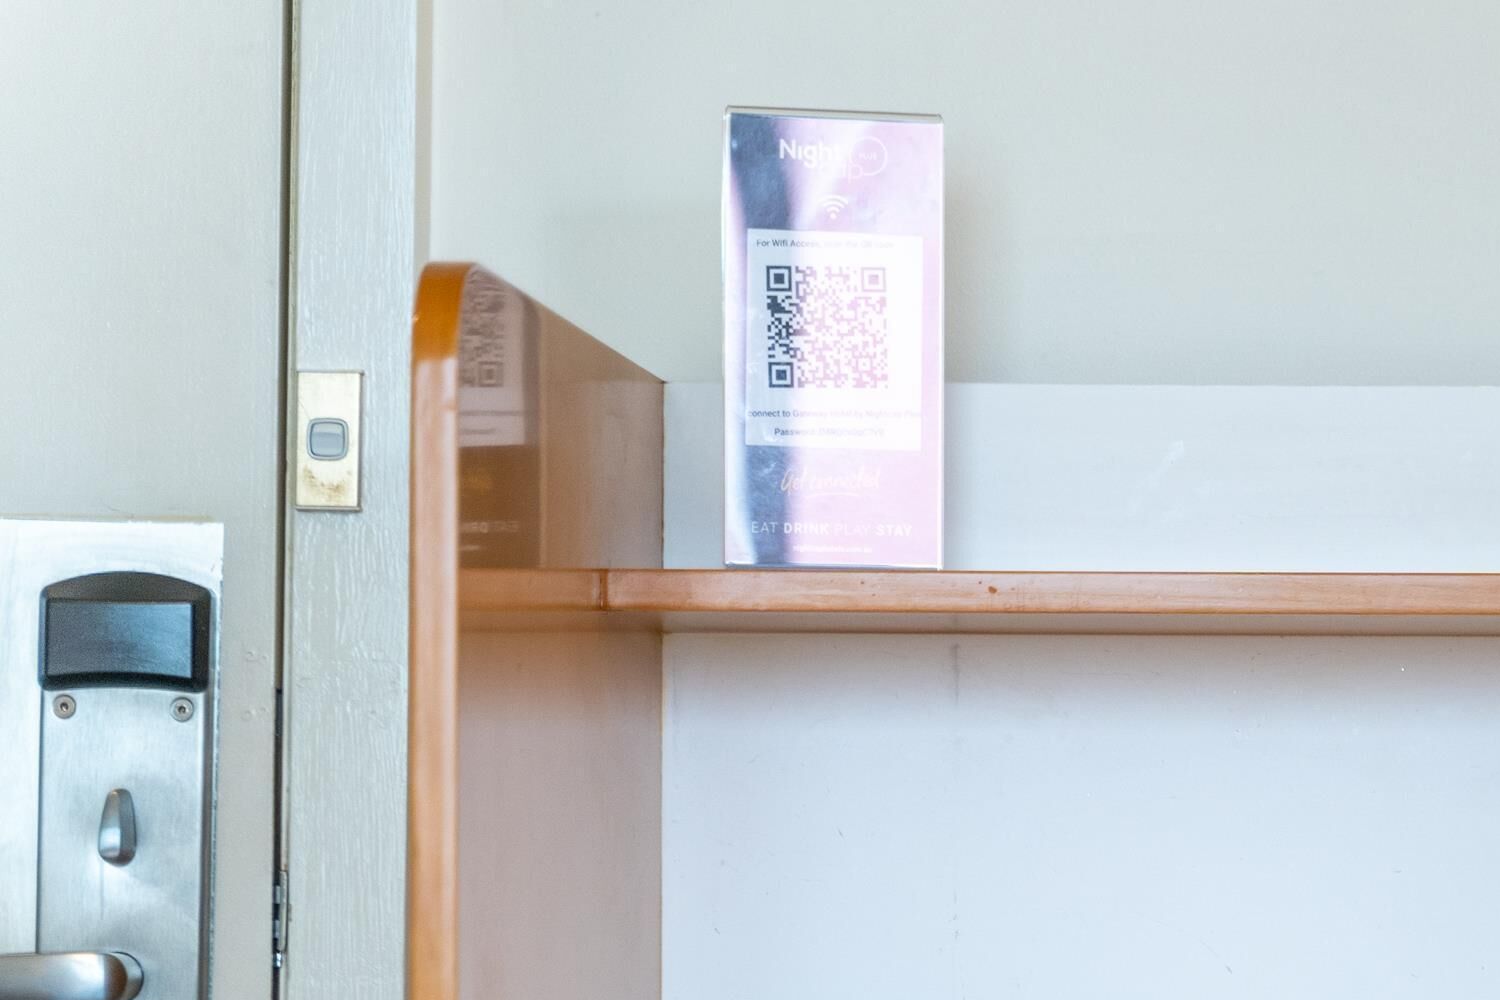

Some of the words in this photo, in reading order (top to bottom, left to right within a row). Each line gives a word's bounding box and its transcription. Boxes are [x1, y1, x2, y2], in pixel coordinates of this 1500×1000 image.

[756, 239, 770, 247] For
[782, 409, 791, 418] to
[751, 521, 779, 534] EAT
[783, 522, 830, 535] DRINK
[874, 524, 913, 537] STAY
